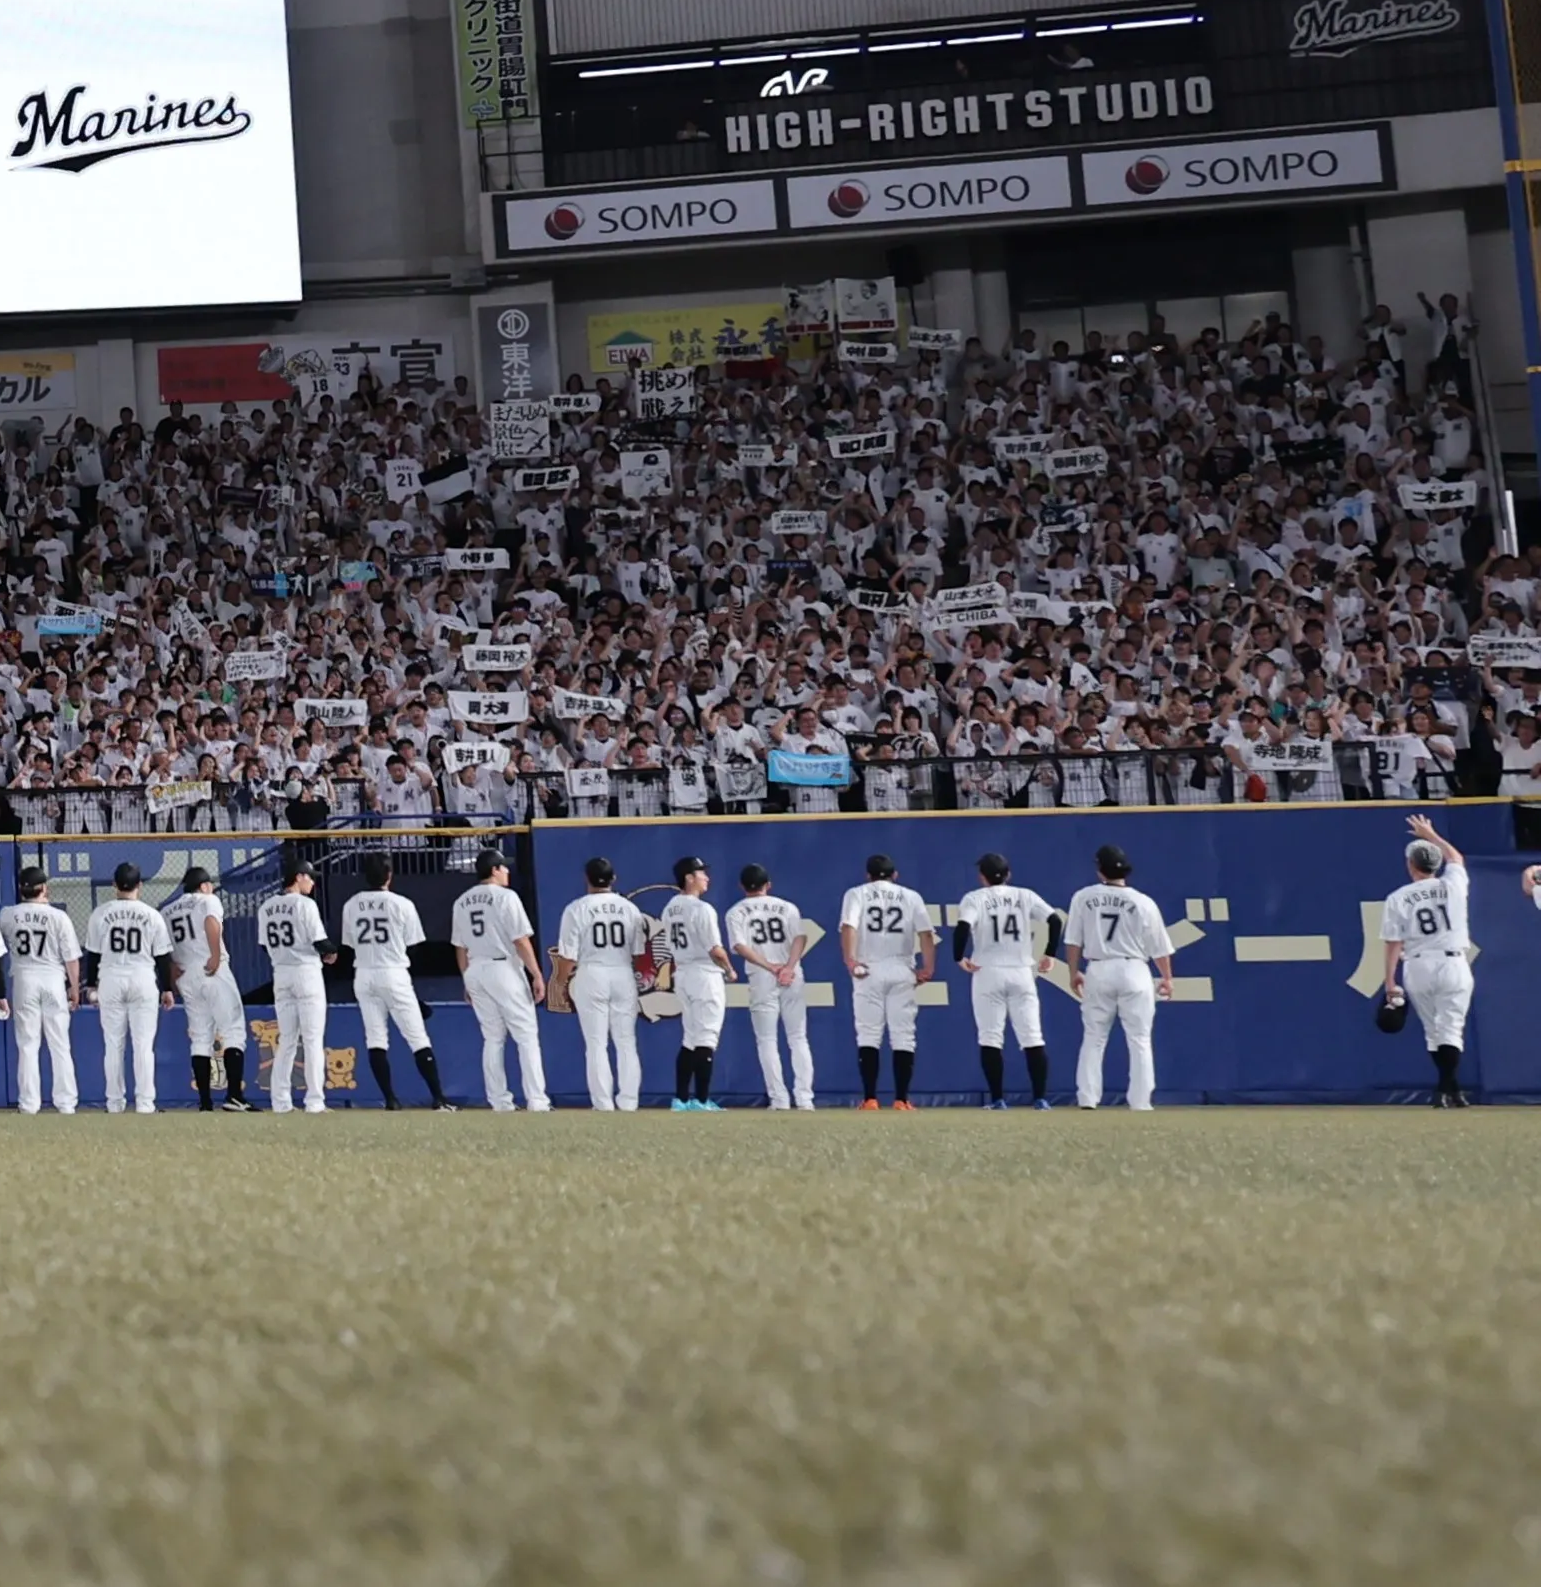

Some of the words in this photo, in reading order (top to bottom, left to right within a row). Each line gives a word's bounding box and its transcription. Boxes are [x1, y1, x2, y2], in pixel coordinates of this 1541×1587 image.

[8, 86, 252, 171] Marines
[1184, 150, 1339, 188] SOMPO
[884, 175, 1030, 212] SOMPO
[598, 198, 738, 234] SOMPO
[608, 348, 650, 364] EIWA
[501, 342, 534, 403] 東洋
[956, 609, 999, 622] CHIBA
[1376, 750, 1401, 770] 81
[265, 905, 294, 918] WADA
[359, 900, 385, 912] OKA
[866, 906, 904, 933] 32
[1086, 898, 1136, 915] FUJIOKA
[171, 915, 195, 944] 51
[356, 918, 389, 944] 25
[470, 910, 485, 937] 5
[751, 918, 786, 945] 38
[990, 914, 1020, 942] 14
[1100, 914, 1120, 942] 7
[1417, 905, 1453, 935] 81
[16, 931, 47, 957] 37
[109, 927, 141, 954] 60
[266, 921, 295, 948] 63
[592, 920, 625, 949] 00
[670, 922, 688, 950] 45
